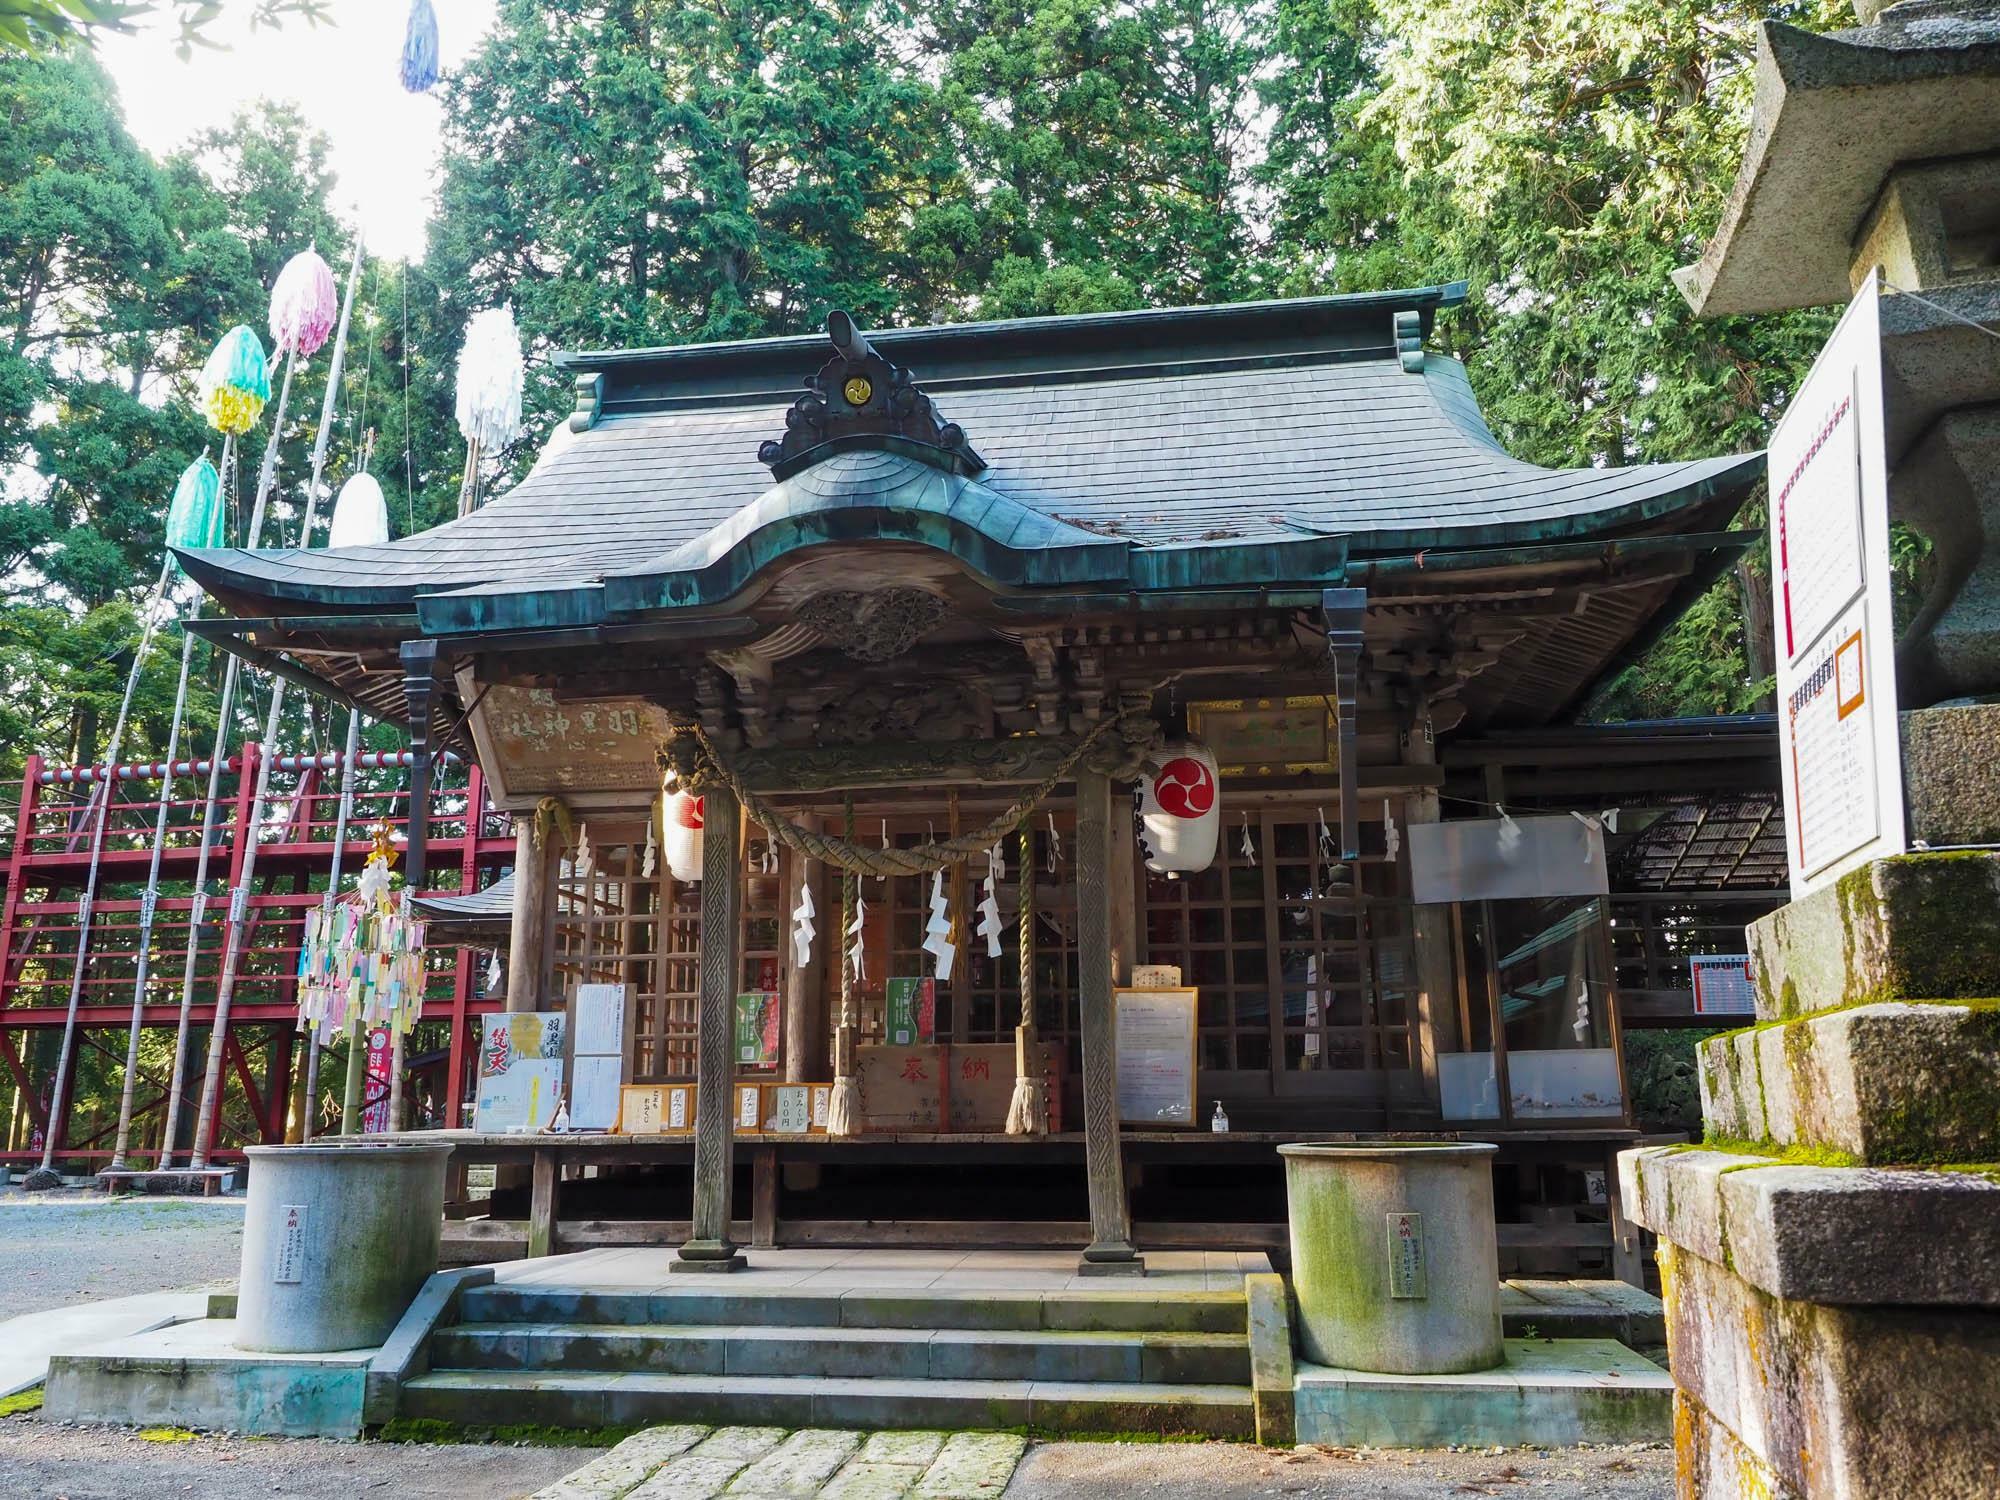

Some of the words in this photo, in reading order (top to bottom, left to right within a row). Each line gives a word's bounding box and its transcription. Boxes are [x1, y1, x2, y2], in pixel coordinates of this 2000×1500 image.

[487, 1026, 509, 1073] 梵天
[545, 1017, 560, 1058] 羽黒山
[899, 1057, 990, 1084] 奉納
[795, 1089, 805, 1127] おみくじ
